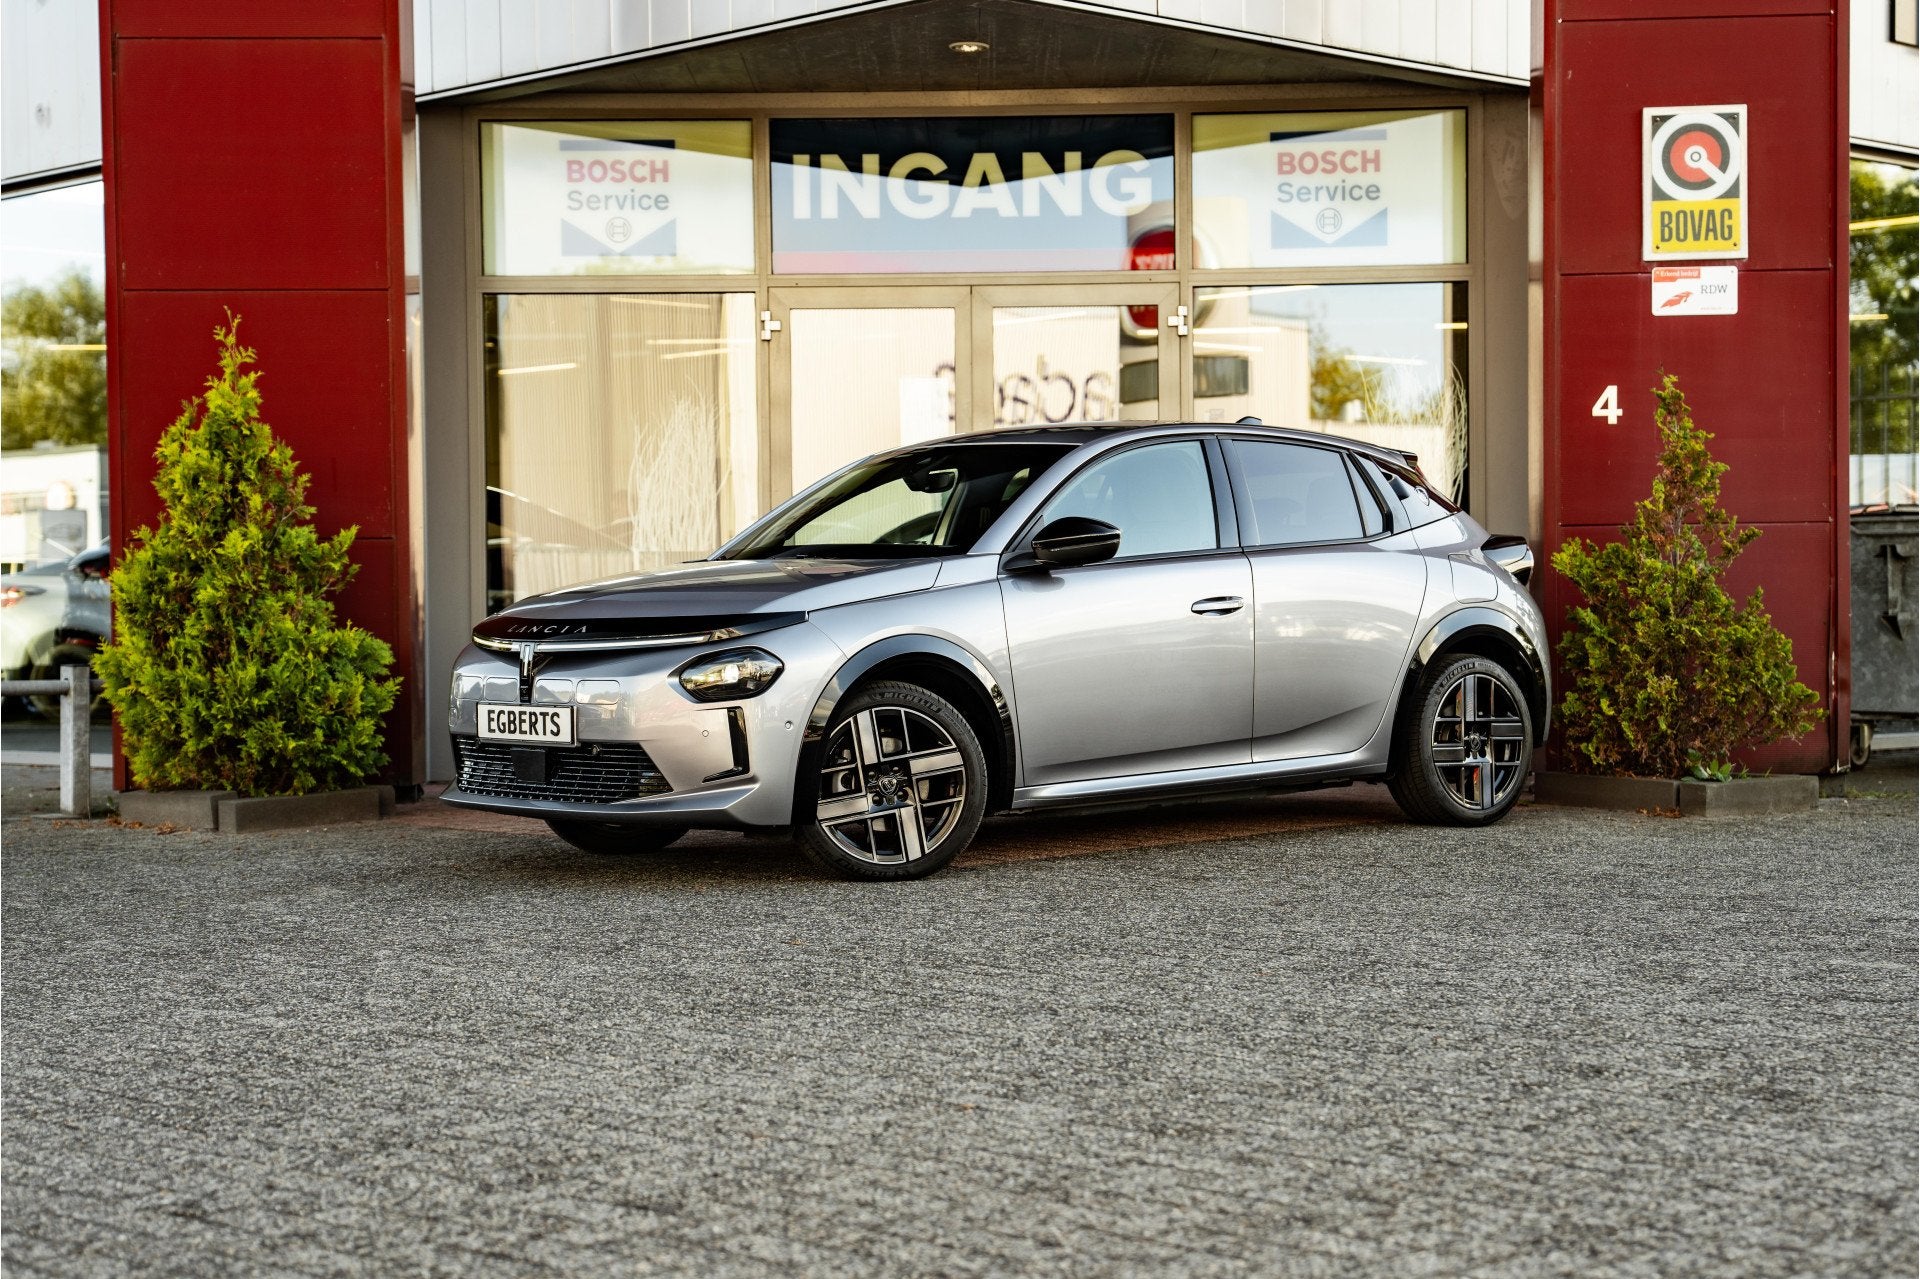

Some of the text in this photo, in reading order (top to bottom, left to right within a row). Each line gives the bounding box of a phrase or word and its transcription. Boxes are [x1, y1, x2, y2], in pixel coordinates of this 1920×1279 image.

[567, 159, 669, 183] BOSCH
[1277, 149, 1381, 175] BOSCH
[792, 150, 1153, 219] INGANG
[1277, 179, 1381, 203] Service
[567, 188, 670, 211] Service
[1660, 208, 1733, 242] BOVAG
[1701, 284, 1728, 294] RDW
[1592, 385, 1623, 425] 4
[507, 624, 588, 633] LANCIA
[884, 691, 942, 714] MICHELIN
[487, 709, 561, 737] EGBERTS
